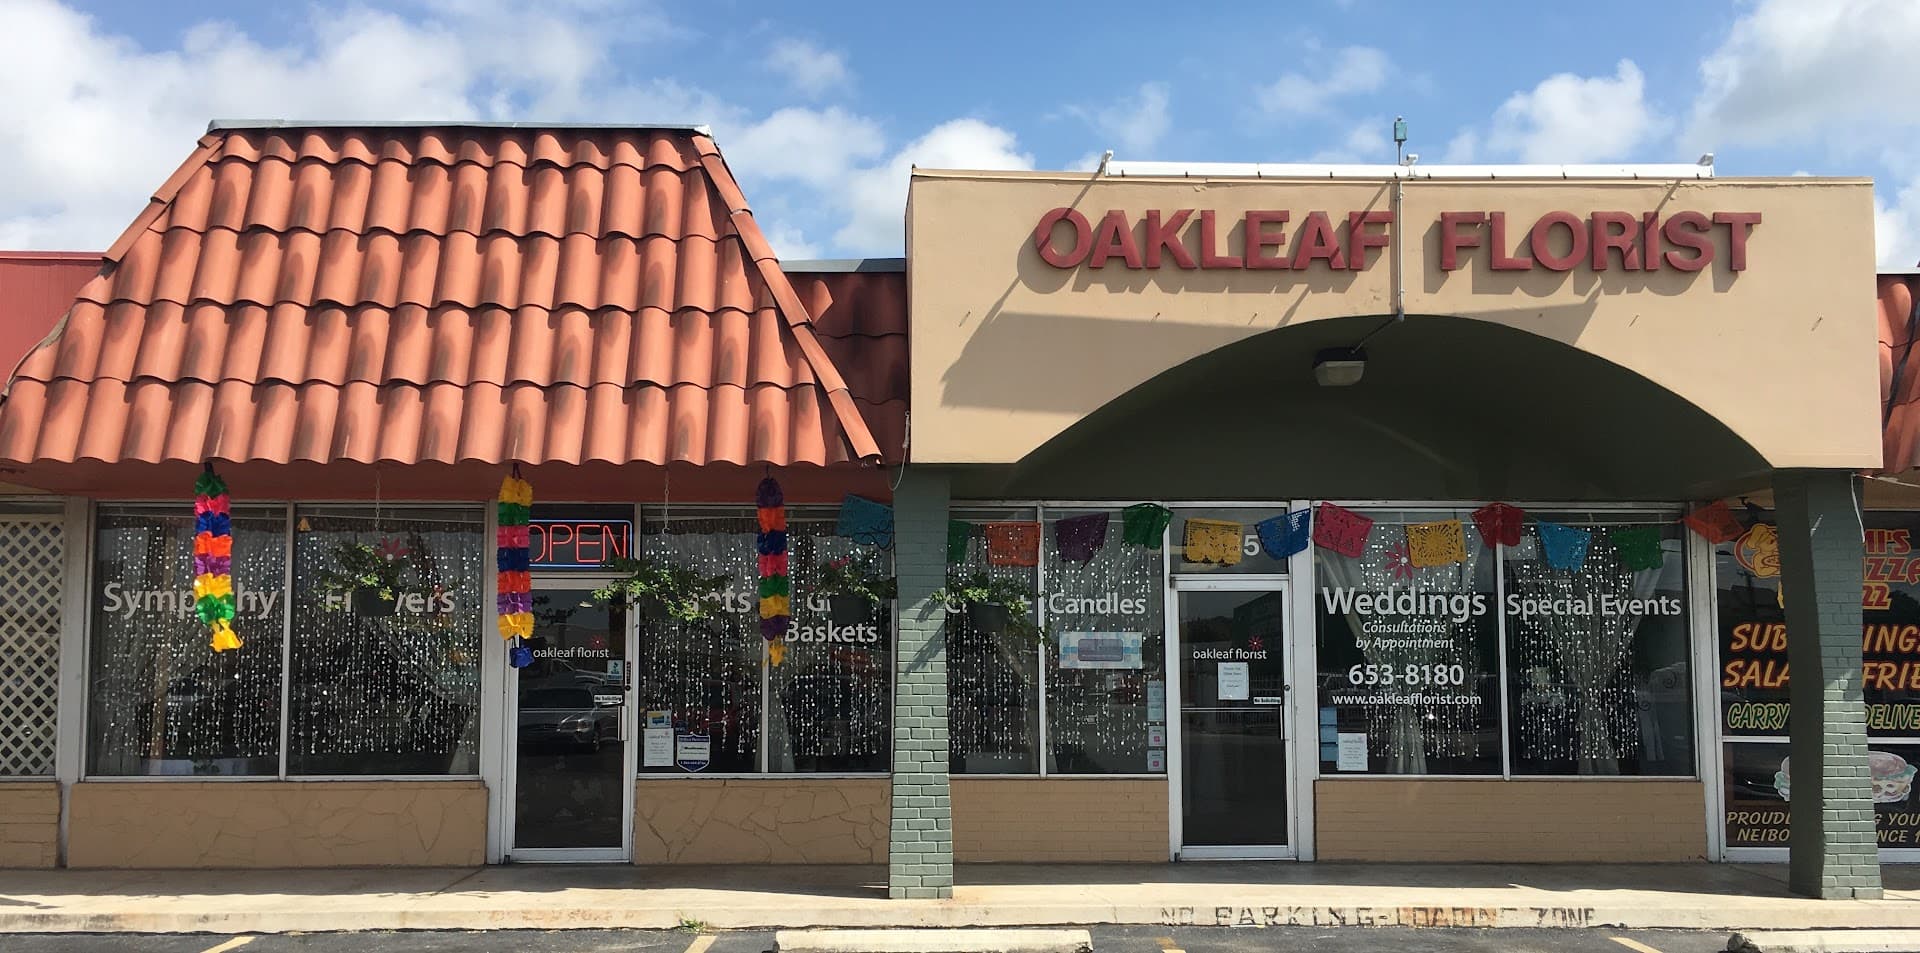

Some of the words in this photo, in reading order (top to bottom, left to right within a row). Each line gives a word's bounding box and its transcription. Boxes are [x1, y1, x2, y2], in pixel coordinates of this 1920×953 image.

[1035, 207, 1394, 270] OAKLEAF
[1441, 210, 1762, 272] FLORIST
[528, 524, 627, 562] OPEN
[103, 583, 278, 620] Symphy
[1049, 592, 1146, 615] Candles
[1322, 586, 1487, 623] Weddings
[1507, 594, 1594, 620] Special
[1601, 594, 1681, 616] Events
[785, 620, 877, 642] Baskets
[1362, 621, 1446, 633] Consultations
[533, 647, 575, 658] oakleaf
[577, 647, 609, 658] florist
[1193, 648, 1233, 659] oakleaf
[1235, 648, 1267, 659] florist
[1355, 637, 1371, 651] by
[1373, 637, 1454, 650] Appointment
[1349, 664, 1465, 685] 653-8180
[1332, 692, 1482, 705] www.oakleafflorist.com
[1728, 703, 1790, 729] CARRY
